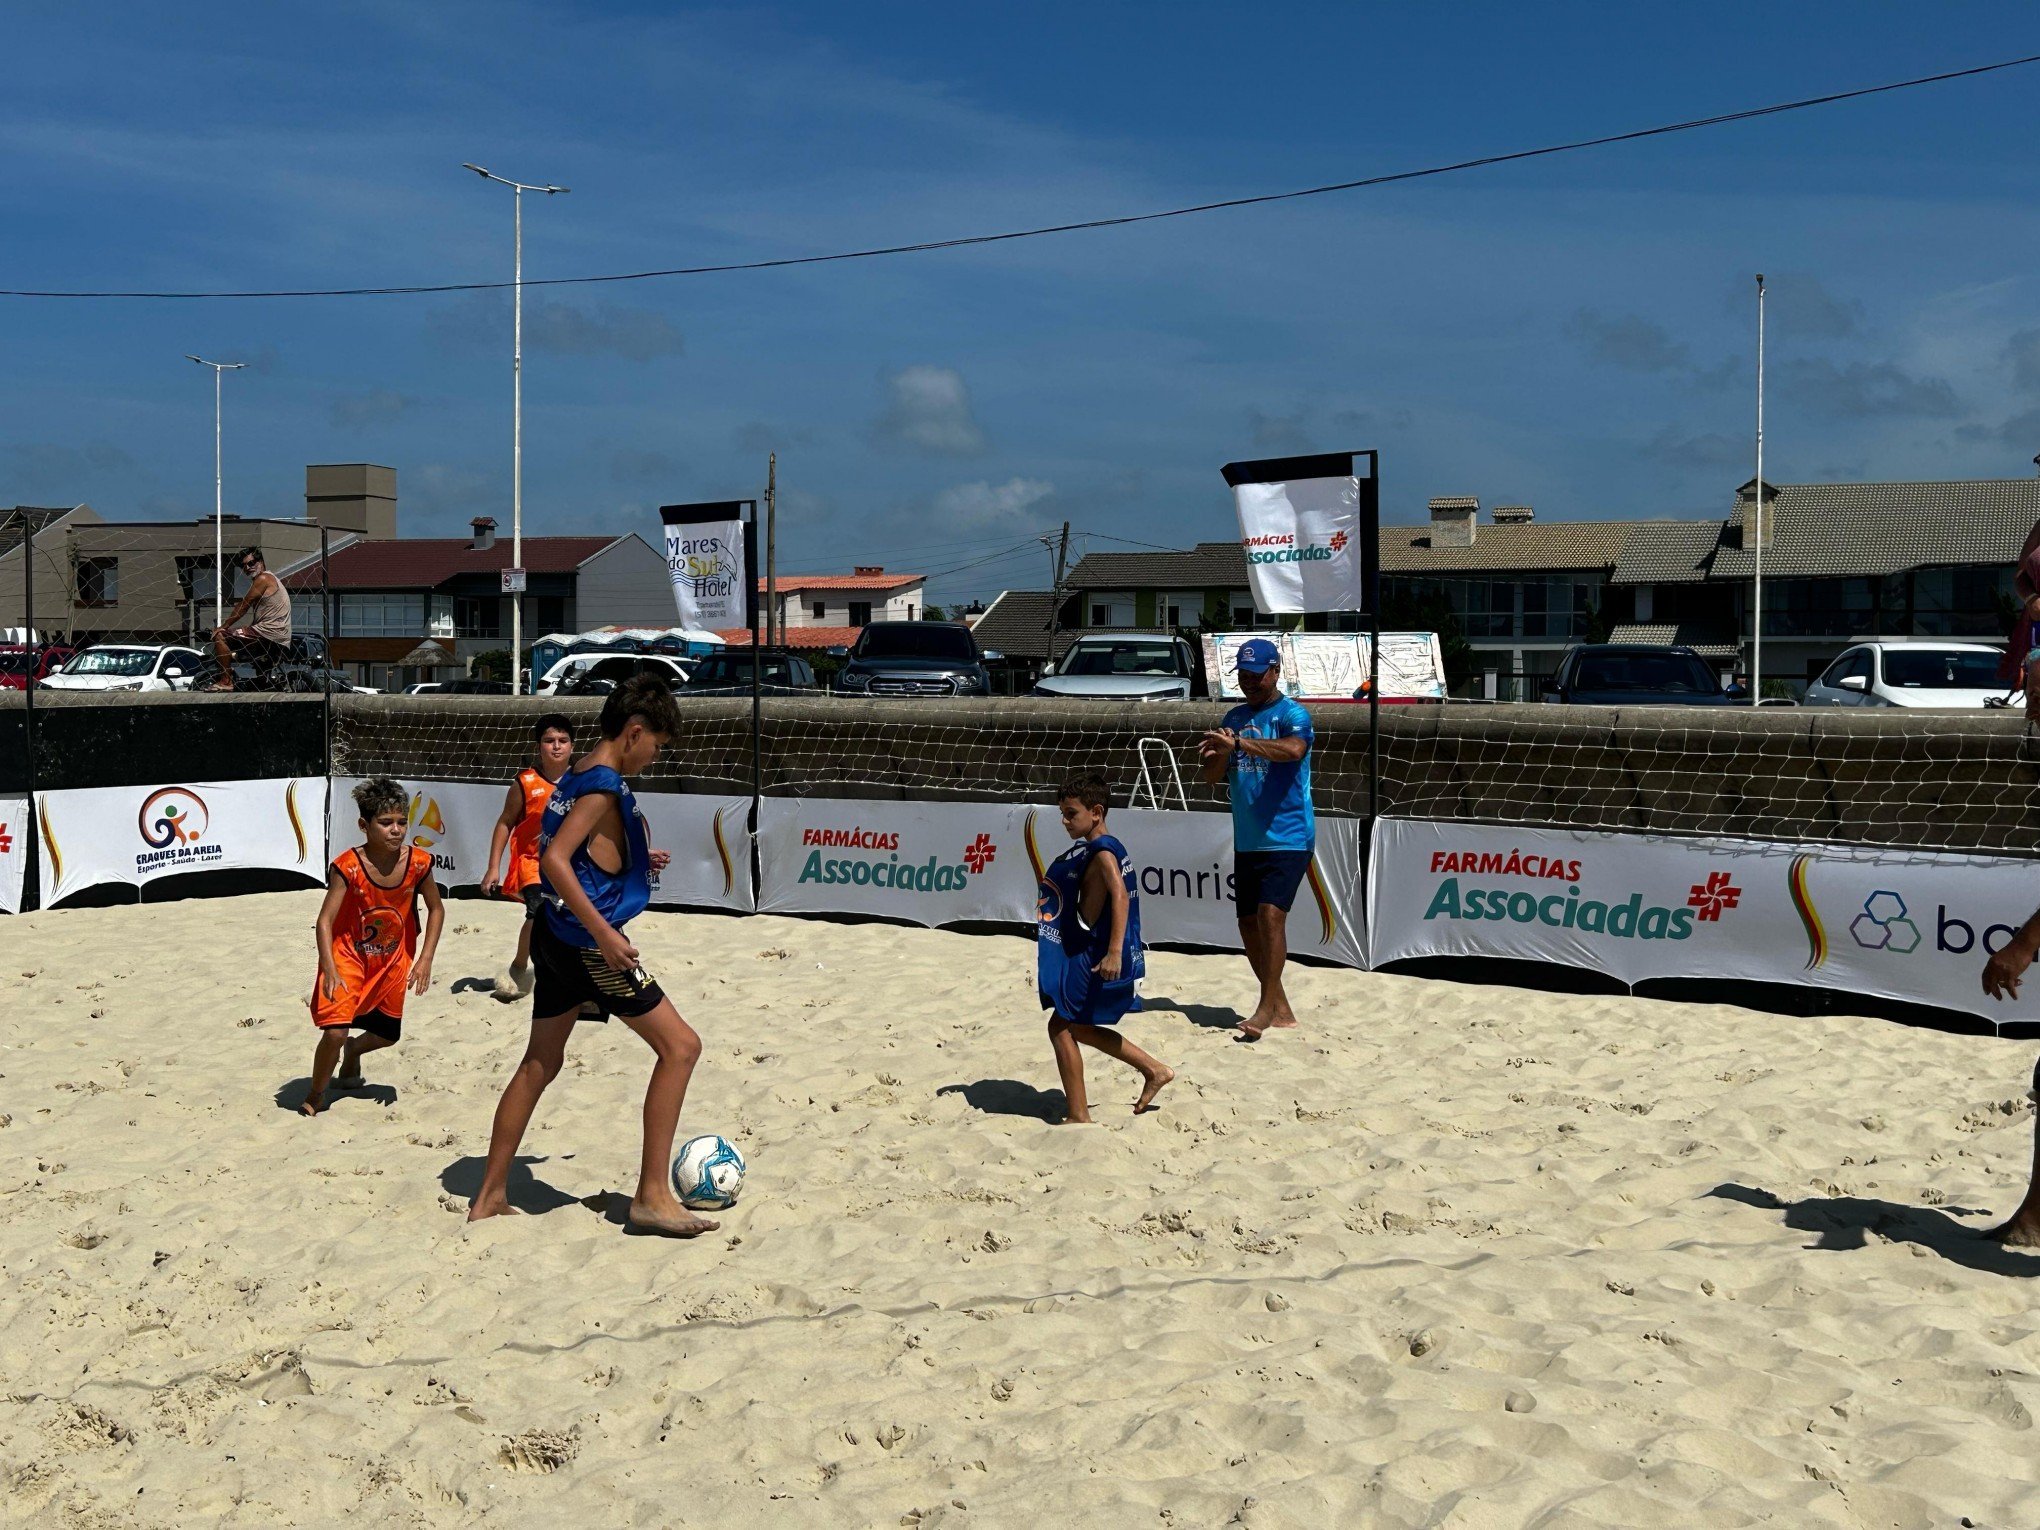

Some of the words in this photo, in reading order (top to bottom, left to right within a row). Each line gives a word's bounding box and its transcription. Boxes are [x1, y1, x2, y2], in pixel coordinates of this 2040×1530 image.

[666, 537, 718, 556] Mares
[1241, 534, 1294, 547] RMÁCIAS
[668, 556, 685, 570] do
[687, 554, 719, 577] Sul
[693, 577, 732, 598] Hotel
[802, 826, 900, 851] FARMÁCIAS
[136, 849, 176, 865] CRAQUES
[178, 847, 192, 858] DA
[193, 844, 222, 856] AREIA
[1430, 848, 1582, 882] FARMÁCIAS
[137, 861, 166, 874] Esporte
[798, 849, 969, 892] Associadas
[1423, 877, 1695, 940] Associadas
[1937, 904, 2039, 962] ba
